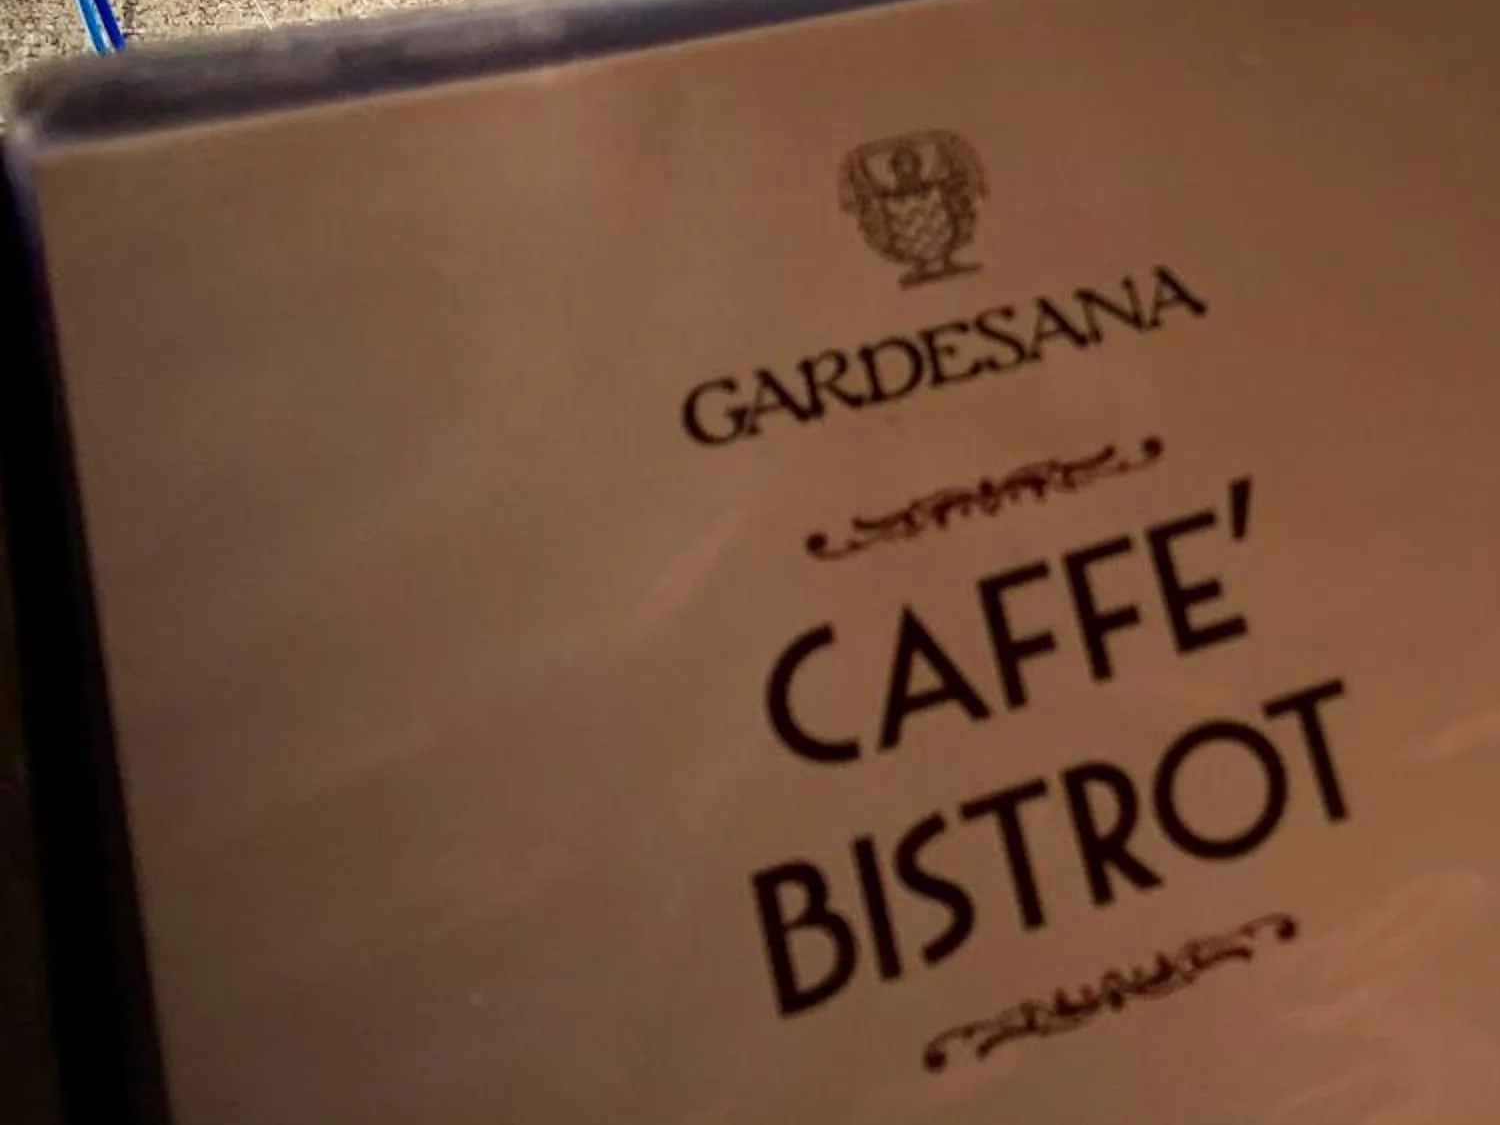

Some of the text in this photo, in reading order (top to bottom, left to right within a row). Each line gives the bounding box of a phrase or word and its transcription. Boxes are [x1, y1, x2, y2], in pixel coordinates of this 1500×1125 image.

[681, 265, 1209, 447] GARDESANA
[764, 475, 1253, 766] CAFFE'
[749, 678, 1350, 1020] BISTROT
